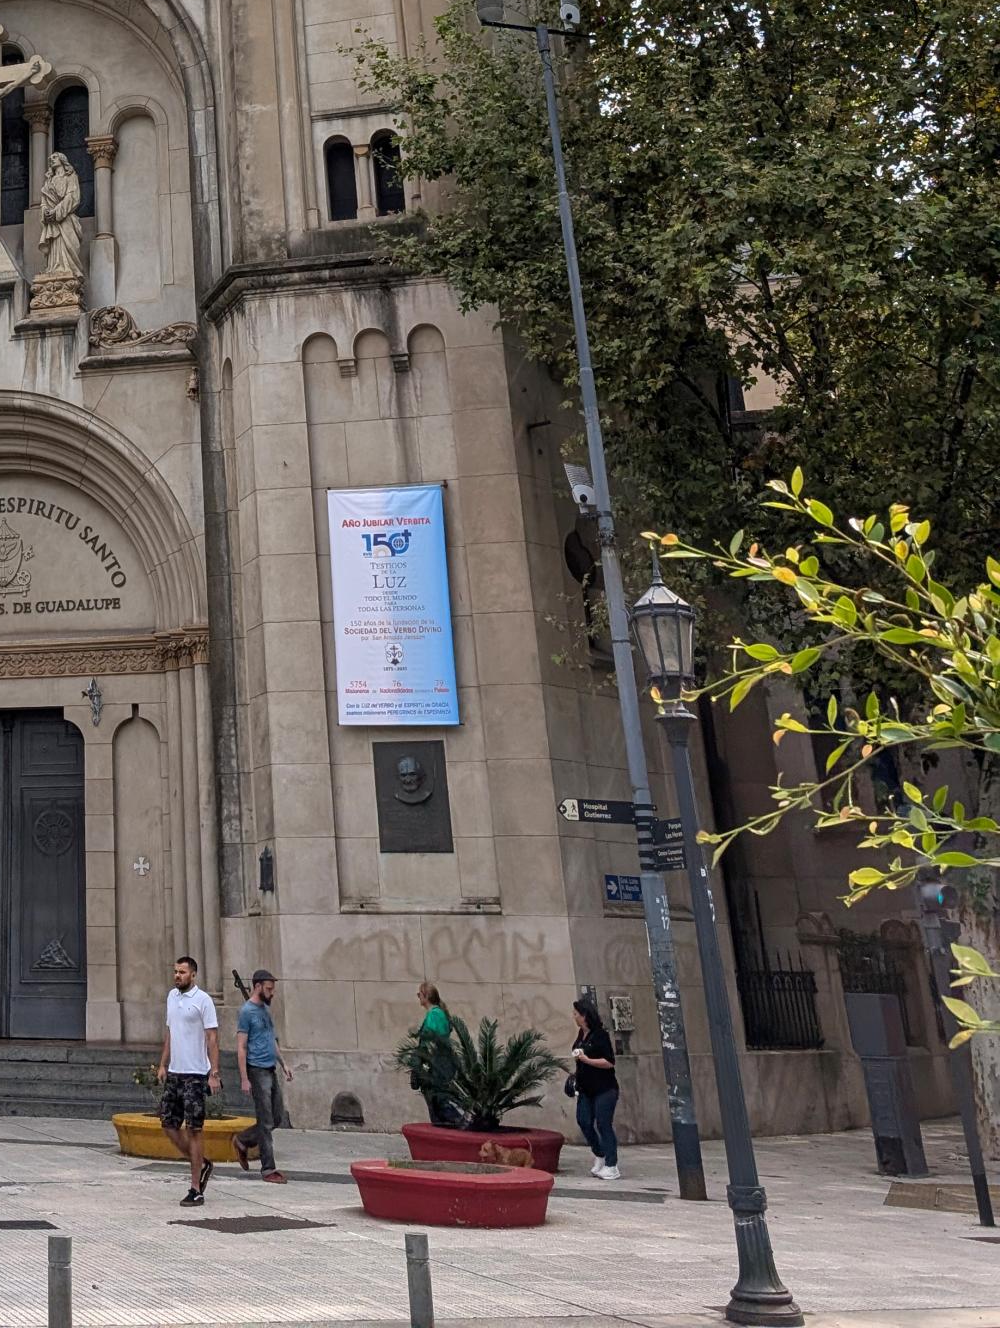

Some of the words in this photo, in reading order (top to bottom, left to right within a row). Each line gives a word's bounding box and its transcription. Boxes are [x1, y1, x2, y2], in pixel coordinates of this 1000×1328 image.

[362, 518, 395, 527] JUBILAR
[79, 526, 127, 589] SANTO
[372, 574, 407, 589] LUZ
[13, 602, 32, 615] DE
[35, 598, 121, 614] GUADALUPE
[344, 627, 378, 635] SOCIEDAD
[393, 626, 417, 634] VERBO
[419, 625, 442, 633] DIVINO
[349, 680, 368, 688] 5754
[583, 802, 608, 811] Hospital
